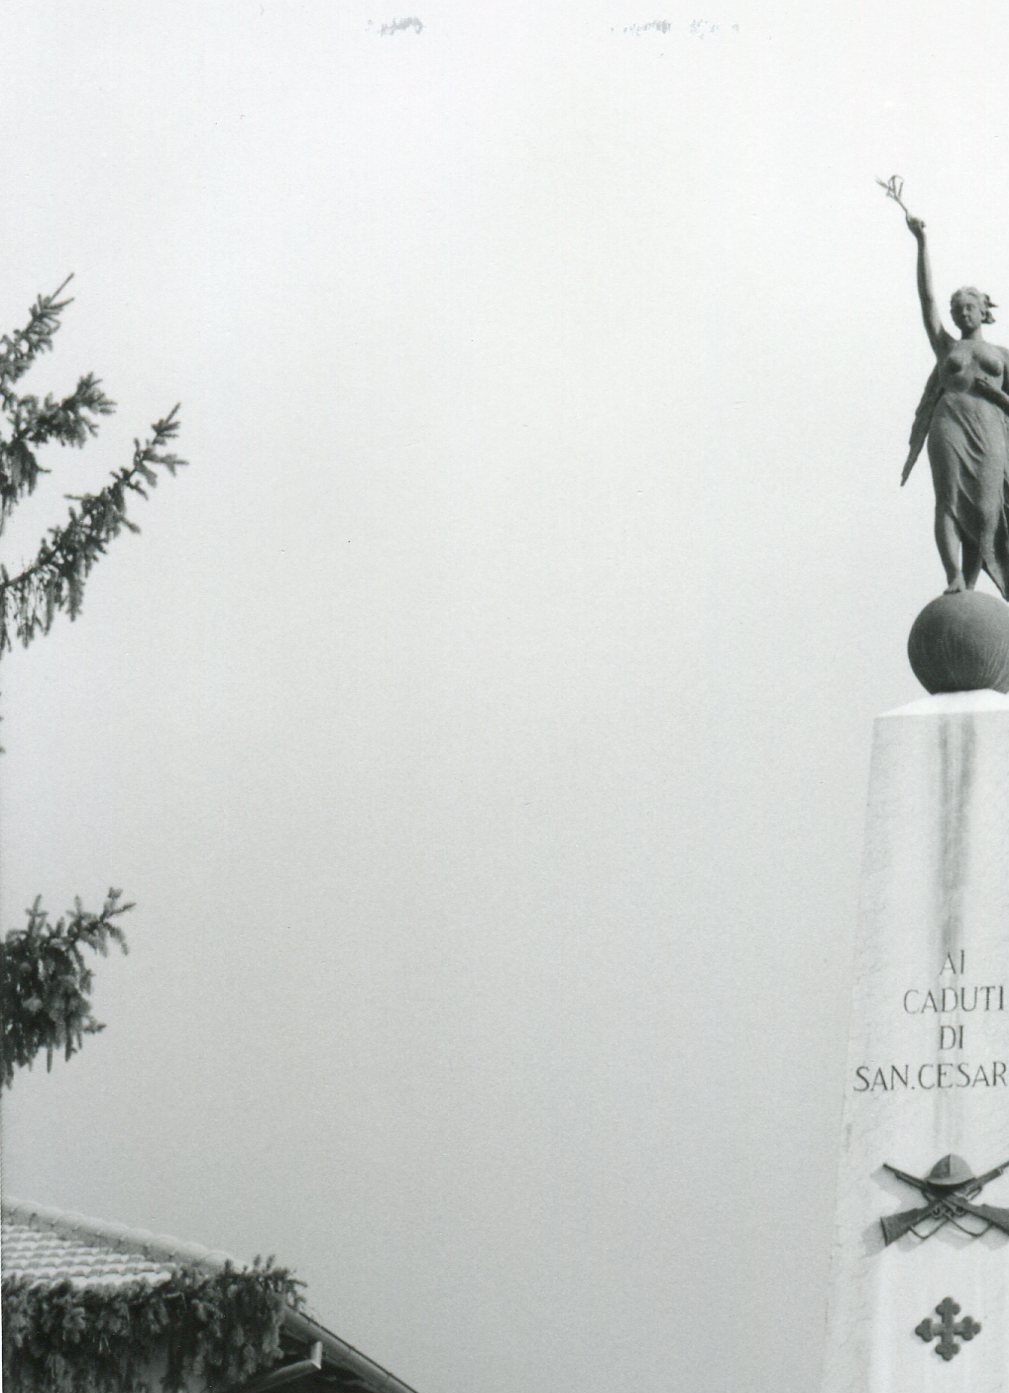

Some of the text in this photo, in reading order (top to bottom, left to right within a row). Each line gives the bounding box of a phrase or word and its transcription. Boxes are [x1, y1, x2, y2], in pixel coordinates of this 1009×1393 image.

[939, 949, 966, 976] AI
[903, 985, 1005, 1015] CADUTI
[937, 1025, 965, 1051] DI
